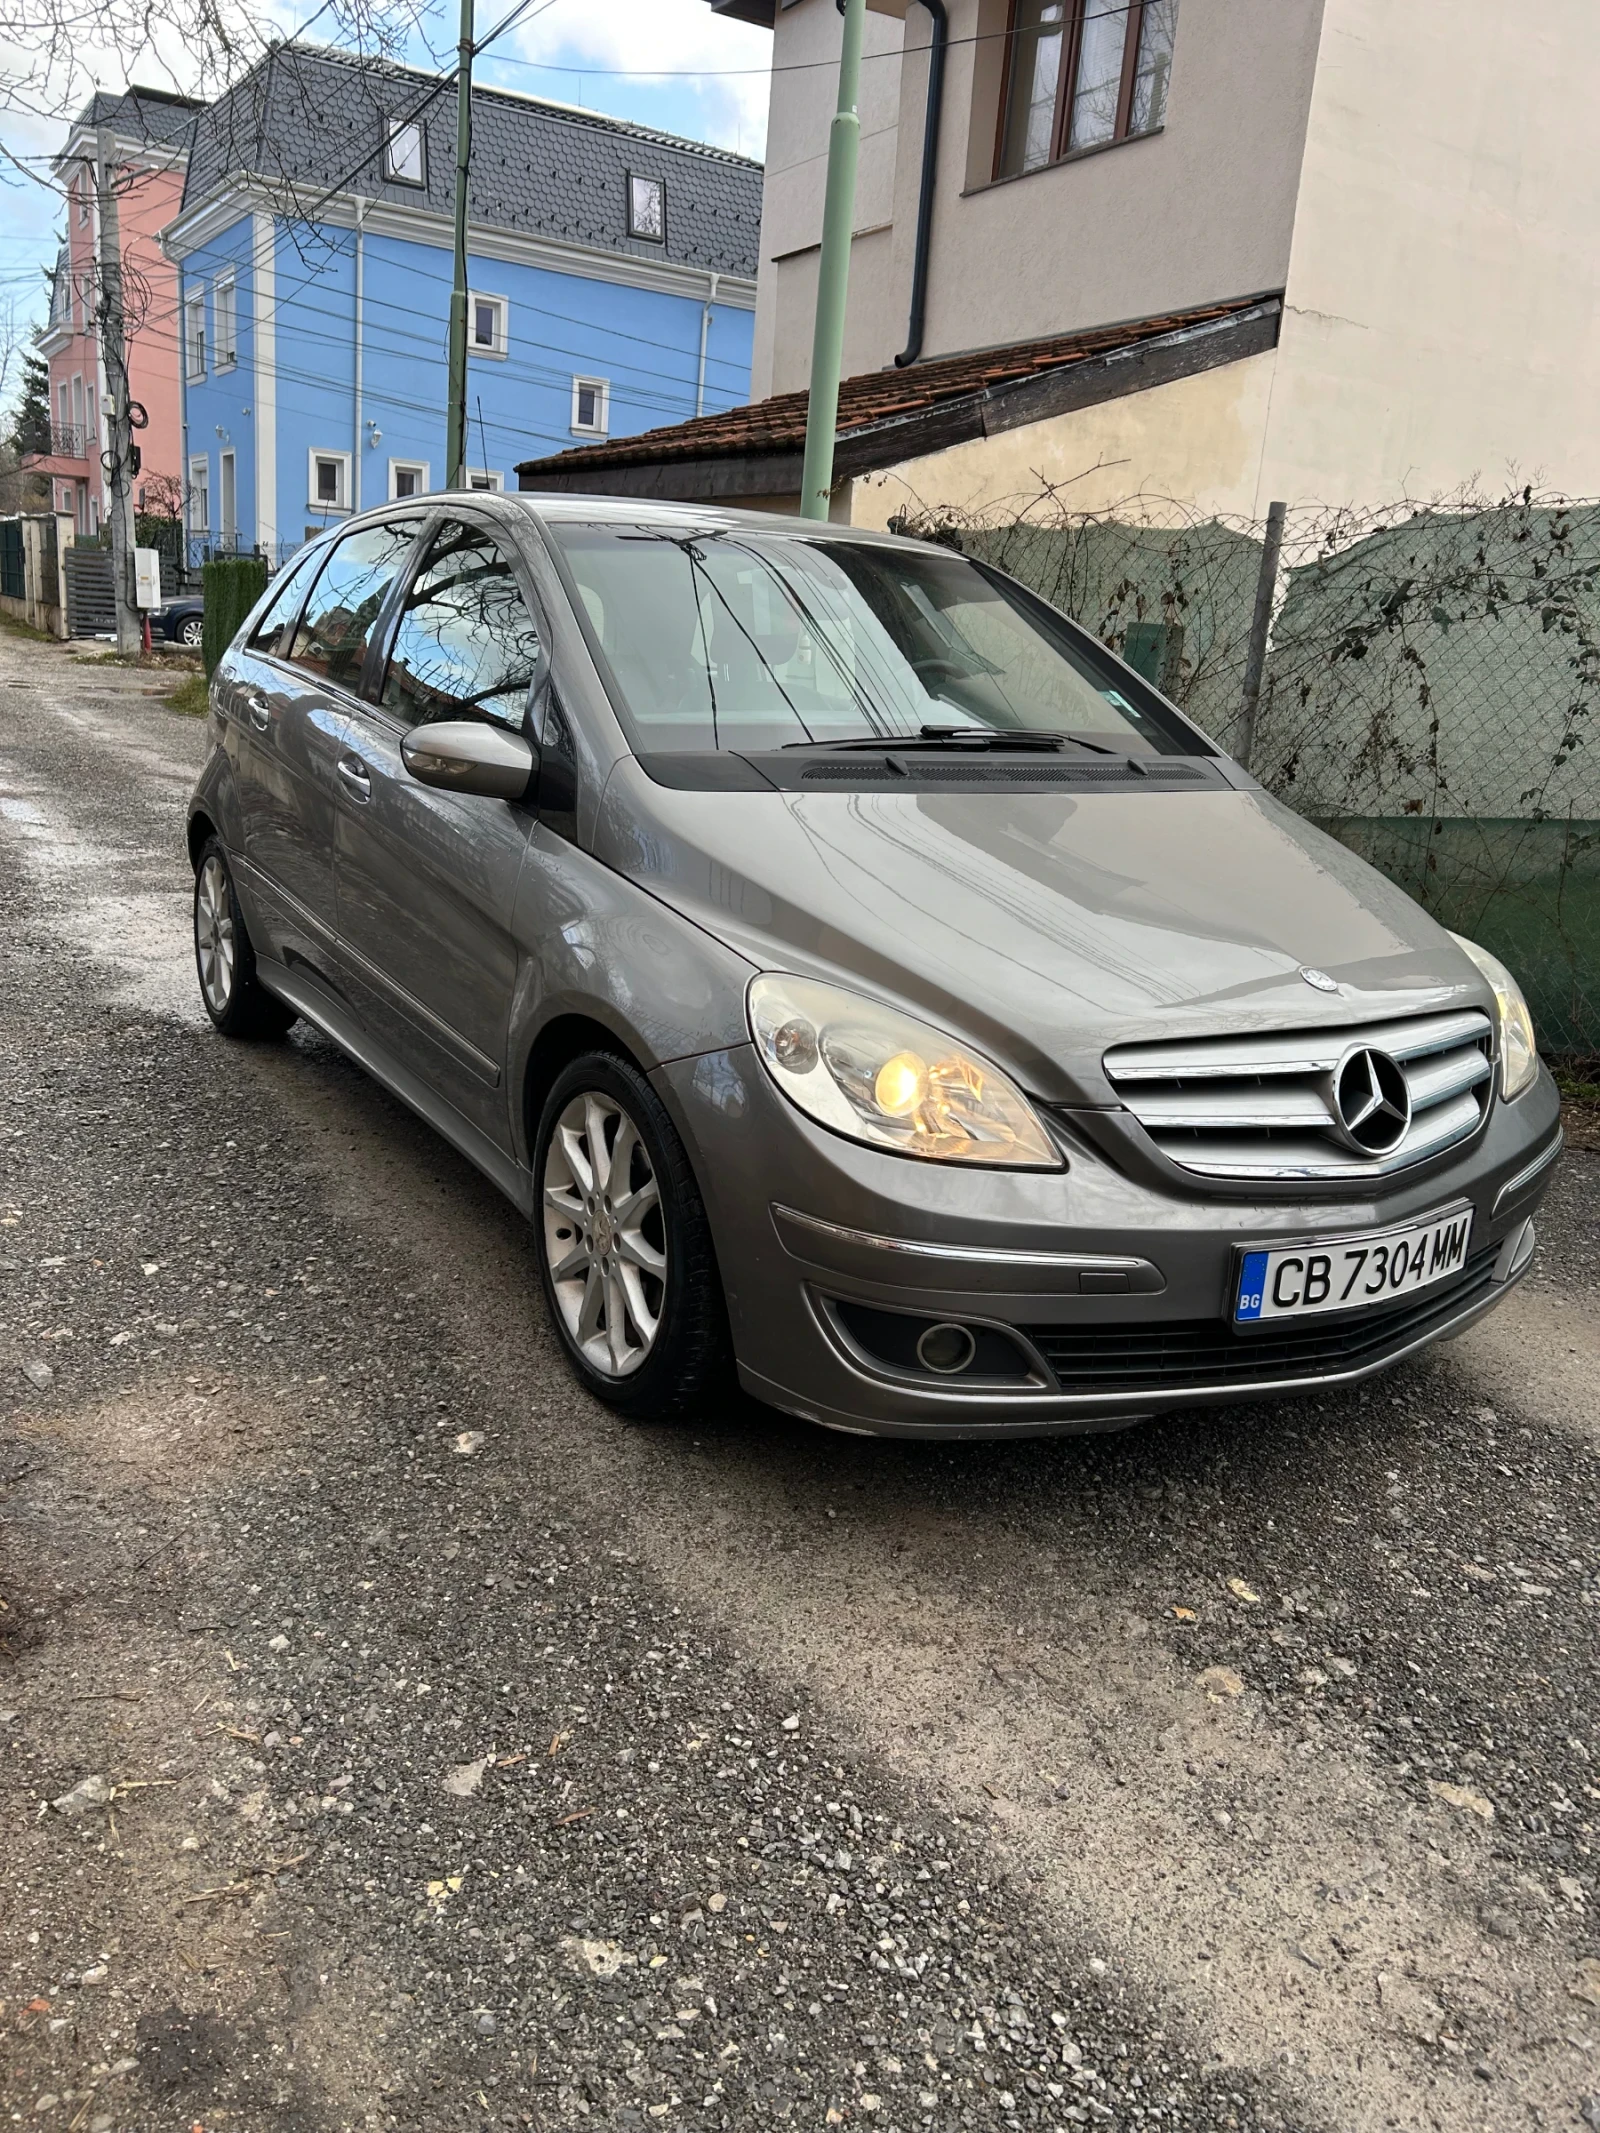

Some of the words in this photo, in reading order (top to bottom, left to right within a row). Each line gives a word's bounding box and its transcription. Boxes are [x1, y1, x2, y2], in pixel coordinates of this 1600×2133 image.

[1273, 1255, 1331, 1307] CB
[1340, 1233, 1428, 1300] 7304
[1429, 1217, 1468, 1275] MM
[1240, 1294, 1260, 1309] BG
